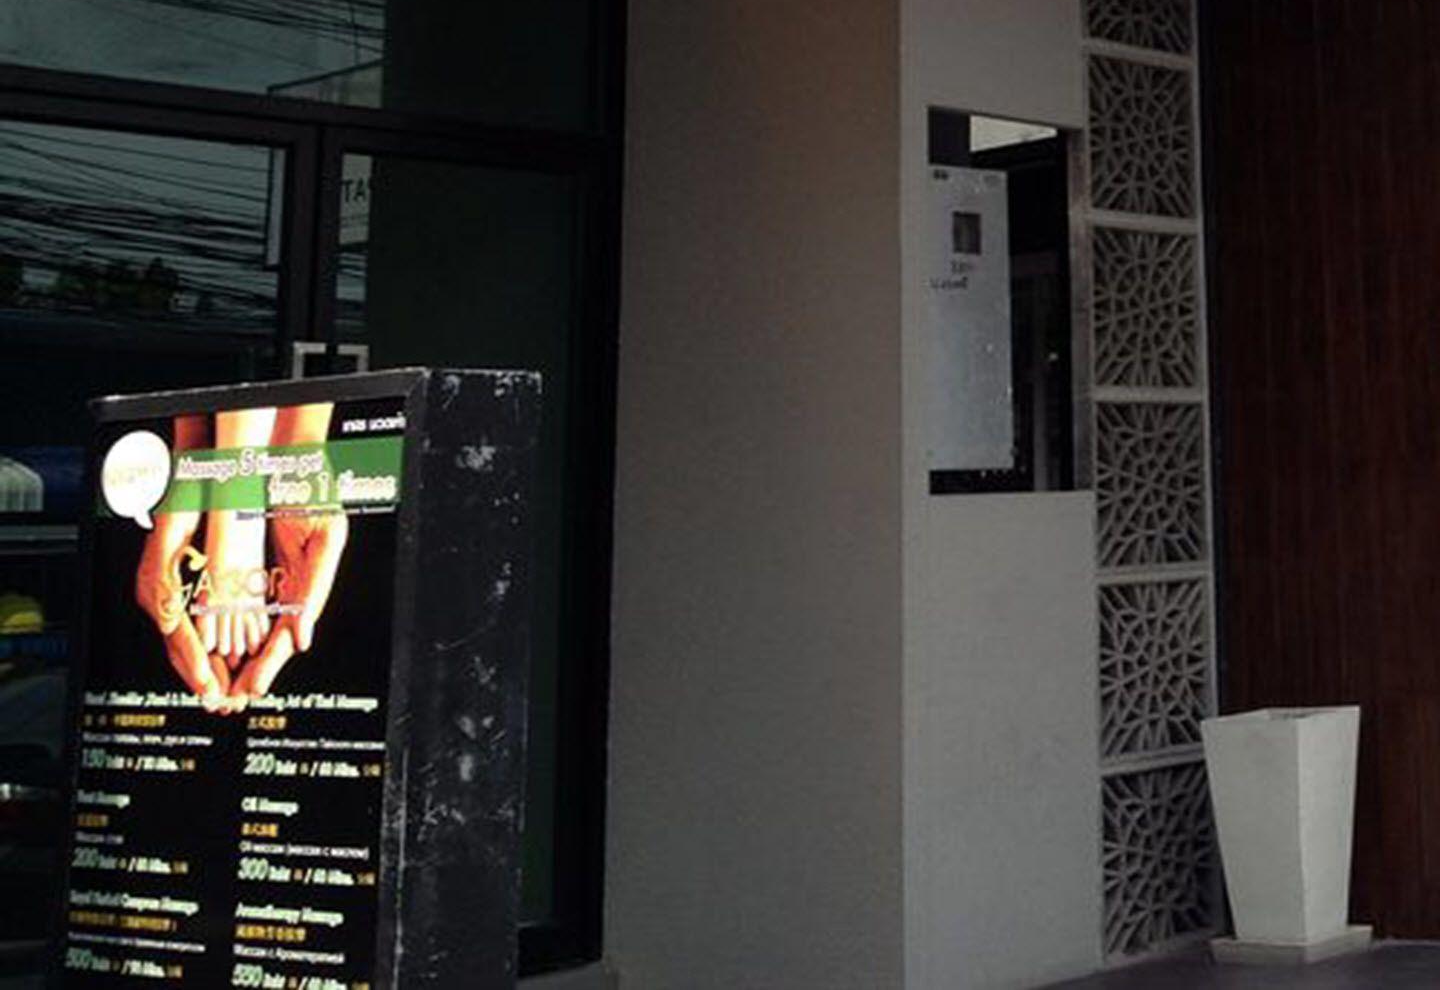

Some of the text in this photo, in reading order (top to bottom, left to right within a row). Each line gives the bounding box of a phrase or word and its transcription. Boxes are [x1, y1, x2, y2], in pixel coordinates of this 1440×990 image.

[176, 457, 237, 483] Massage
[269, 472, 311, 504] free
[318, 472, 330, 502] 1
